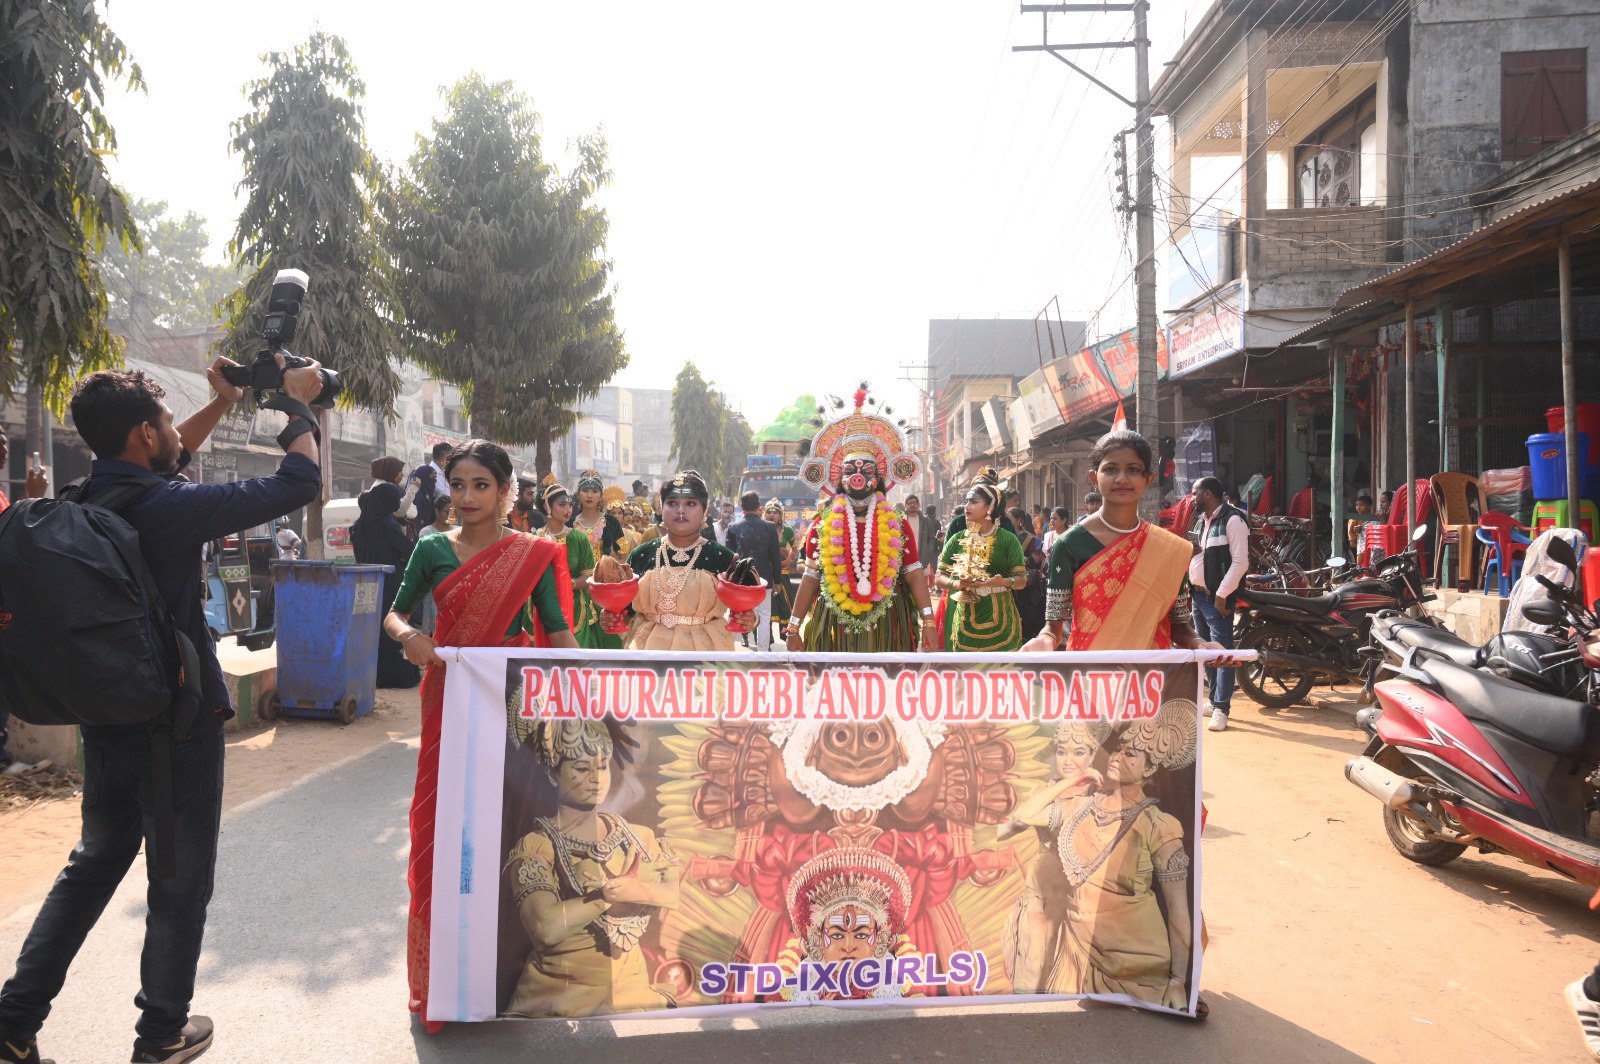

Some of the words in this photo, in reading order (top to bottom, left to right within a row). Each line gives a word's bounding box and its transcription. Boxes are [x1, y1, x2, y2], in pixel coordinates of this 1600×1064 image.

[1176, 355, 1196, 372] SRIRAM
[1053, 372, 1091, 393] LIRA
[229, 431, 247, 441] TAILOR
[1509, 642, 1533, 654] TVS
[521, 667, 717, 720] PANJURALI
[723, 669, 807, 720] DEBI
[813, 670, 887, 721] AND
[895, 670, 1035, 722] GOLDEN
[1040, 670, 1165, 721] DAIVAS
[700, 951, 988, 997] STD-IX(GIRLS)
